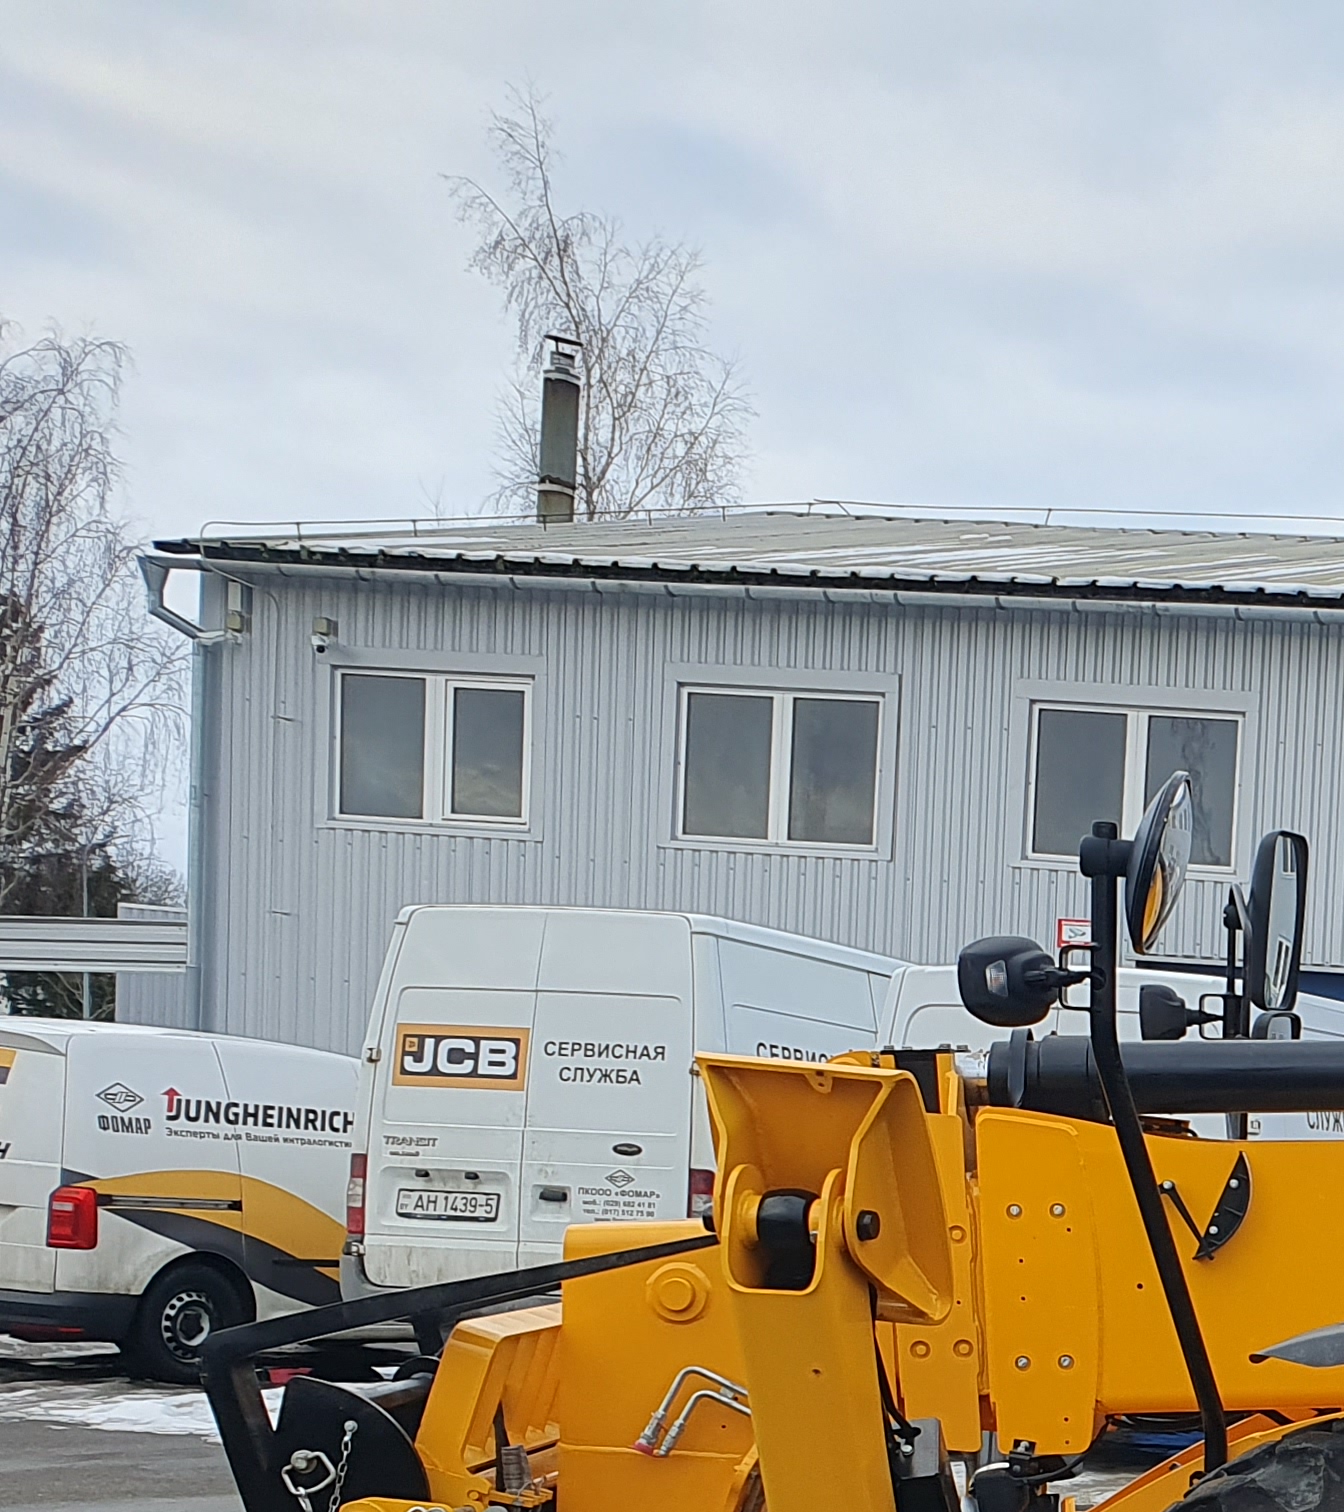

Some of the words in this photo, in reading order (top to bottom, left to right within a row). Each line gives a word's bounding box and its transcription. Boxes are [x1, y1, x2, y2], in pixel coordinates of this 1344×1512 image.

[403, 1038, 517, 1076] JCB
[543, 1041, 666, 1061] СЕРВИСНАЯ
[558, 1066, 641, 1085] СЛУЖБА
[97, 1115, 151, 1135] ФОМАР
[165, 1098, 355, 1134] JUNGHEINRICH
[165, 1126, 221, 1140] Эксперты
[222, 1132, 243, 1142] для
[246, 1132, 281, 1143] Вашей
[443, 1195, 495, 1214] 1439-5
